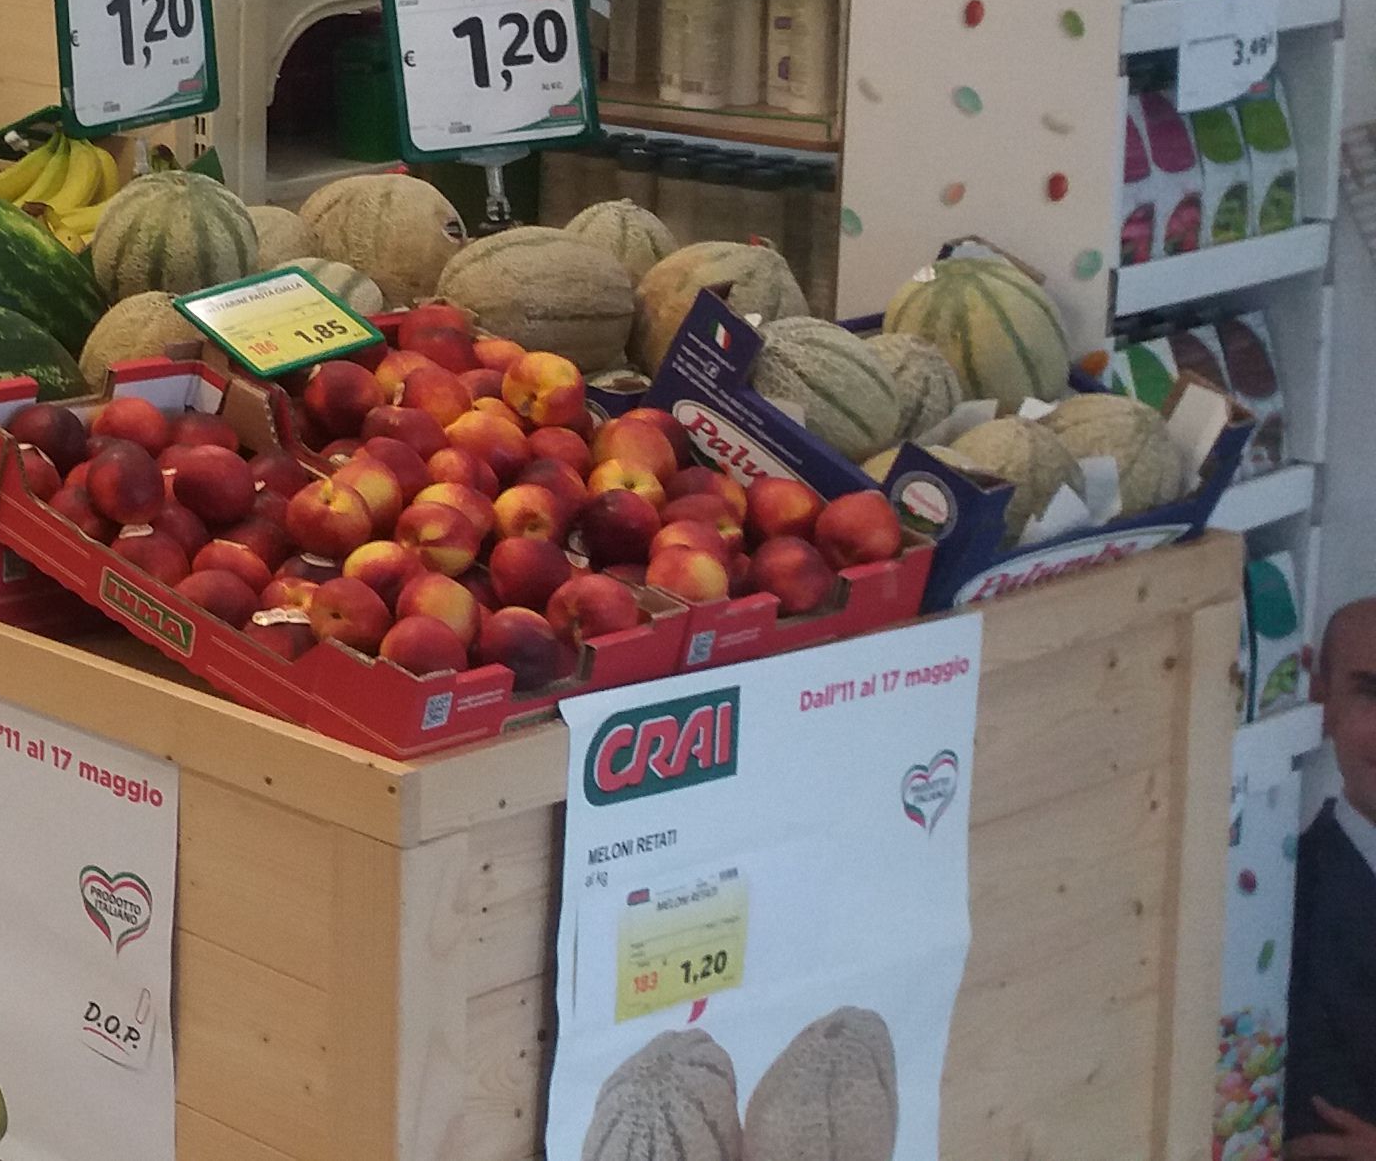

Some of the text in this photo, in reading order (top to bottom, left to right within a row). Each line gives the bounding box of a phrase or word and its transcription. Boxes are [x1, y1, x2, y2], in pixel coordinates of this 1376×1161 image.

[69, 29, 80, 48] €
[403, 8, 569, 93] € 1,20
[294, 319, 348, 345] 1,85
[860, 674, 877, 698] al
[882, 670, 901, 692] 17
[905, 655, 970, 687] maggio
[594, 700, 732, 793] CRAI
[27, 739, 45, 762] al
[51, 745, 73, 771] 17
[79, 760, 164, 807] maggio
[588, 828, 678, 866] MELONI RETATI
[90, 885, 141, 916] PRODOTTO
[94, 900, 138, 926] ITALIANO
[680, 950, 728, 984] 1,20
[83, 1000, 142, 1050] D.O.P.
